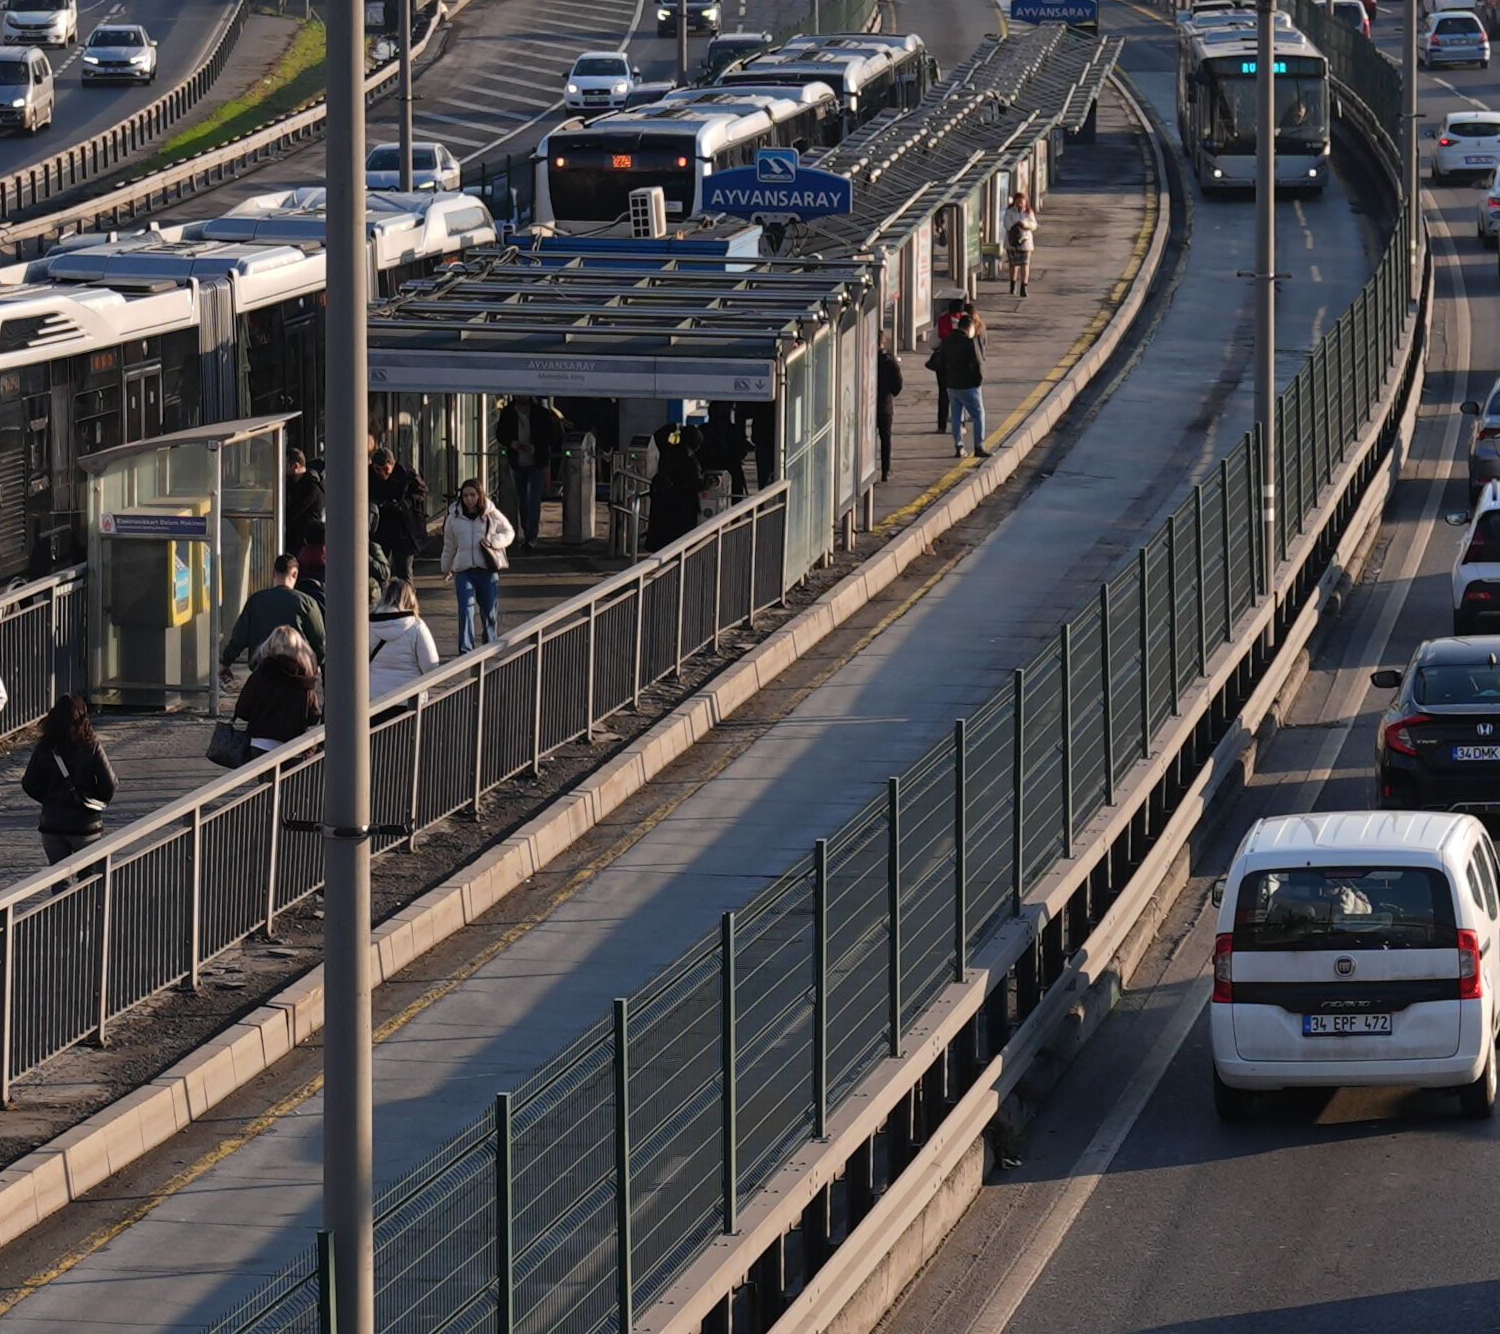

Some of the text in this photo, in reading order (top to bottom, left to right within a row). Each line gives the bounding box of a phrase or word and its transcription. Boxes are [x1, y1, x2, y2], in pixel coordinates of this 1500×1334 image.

[1016, 7, 1092, 18] AYVANSARAY
[711, 190, 843, 209] AYVANSARAY
[528, 360, 596, 371] AYVANSARAY
[1458, 747, 1471, 760] 34
[1473, 747, 1499, 760] DMK
[1311, 1015, 1388, 1031] 34 EPF 472
